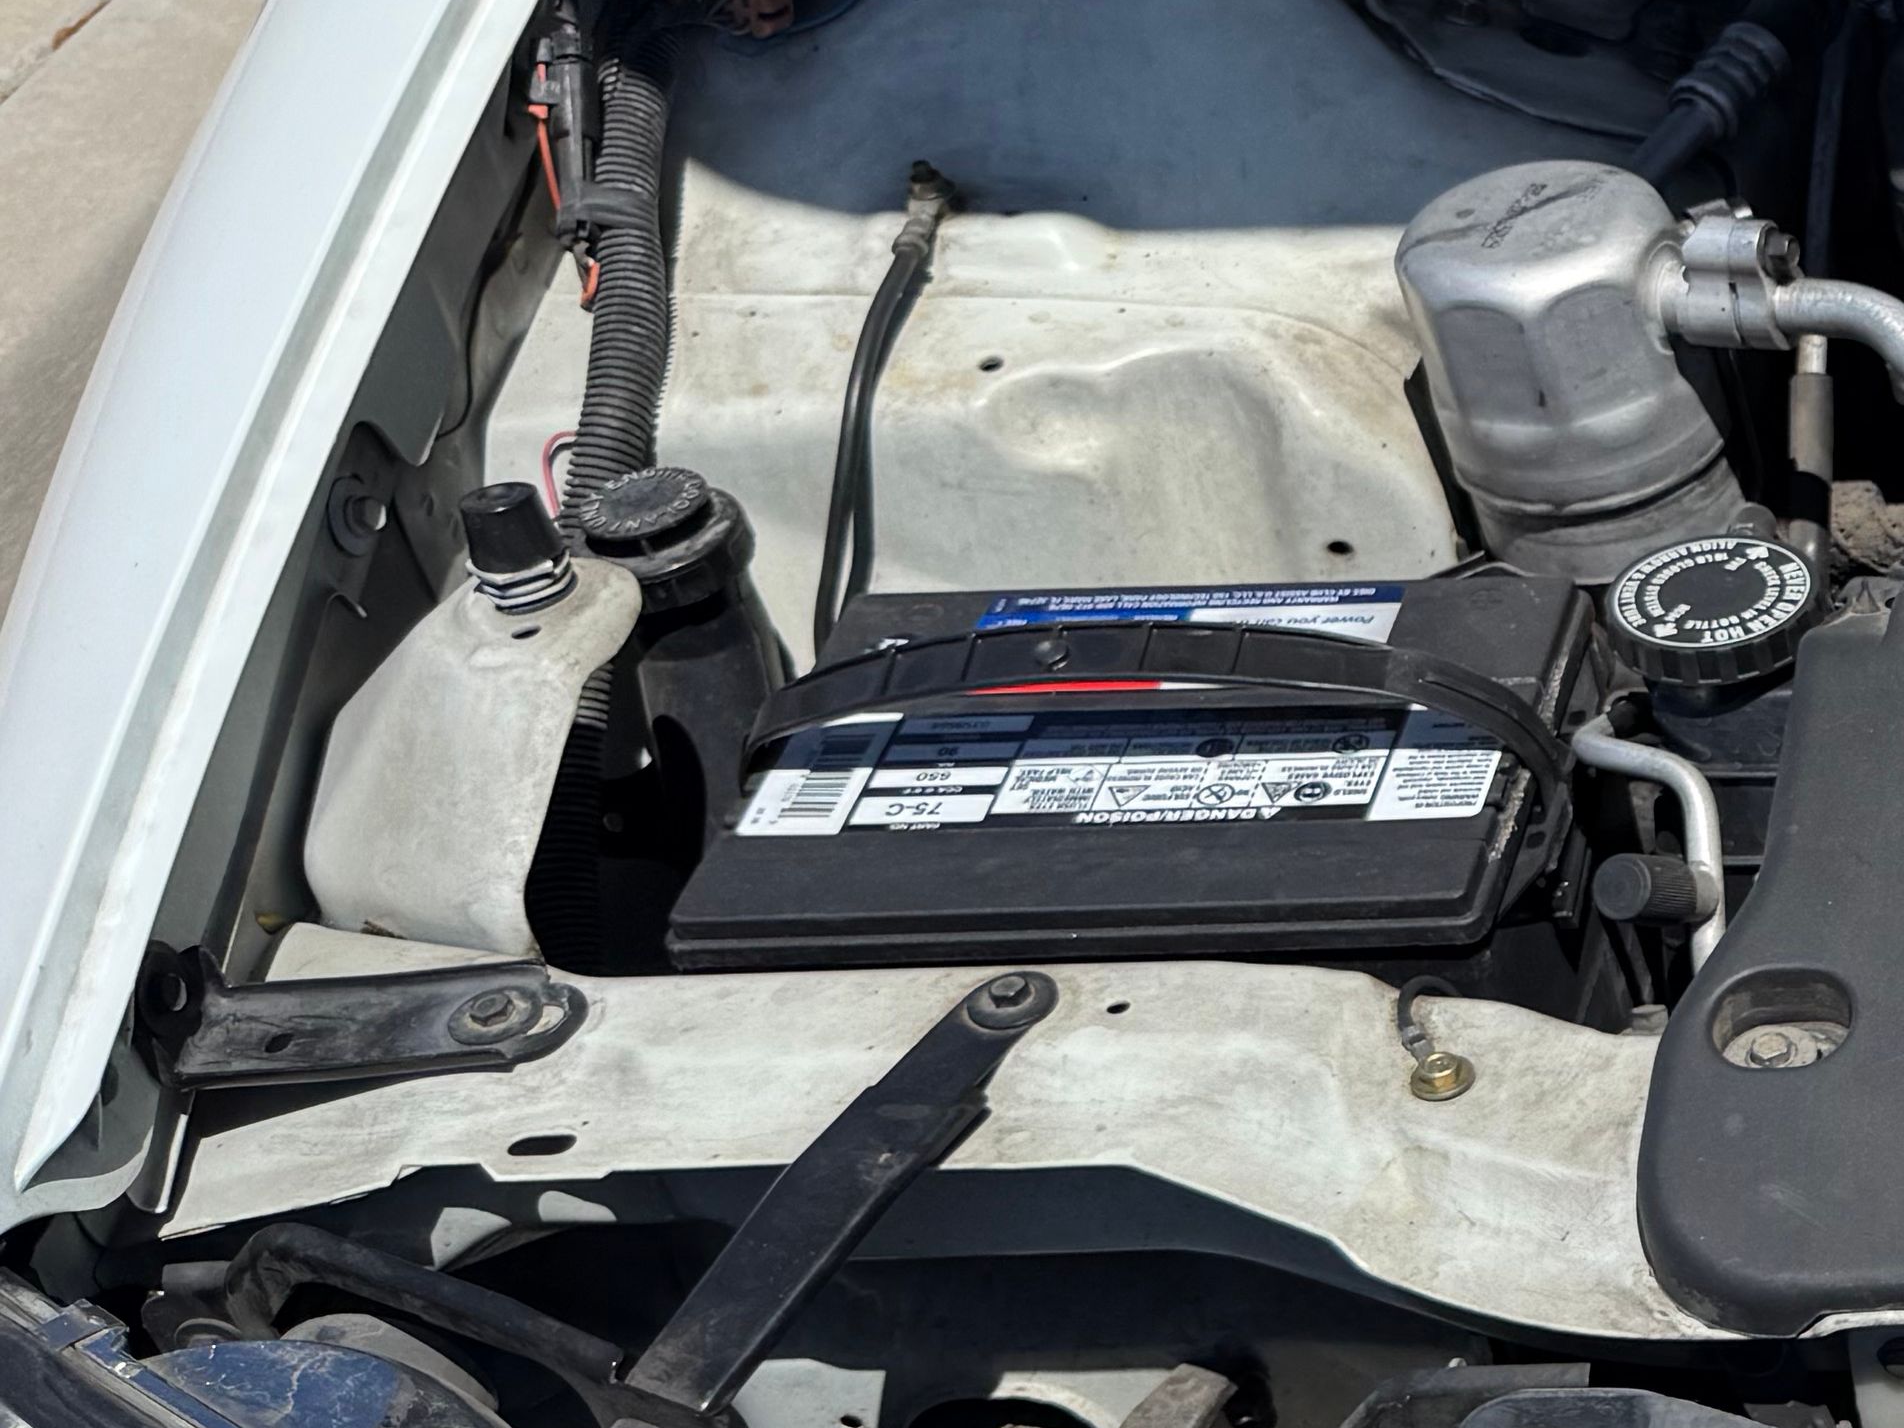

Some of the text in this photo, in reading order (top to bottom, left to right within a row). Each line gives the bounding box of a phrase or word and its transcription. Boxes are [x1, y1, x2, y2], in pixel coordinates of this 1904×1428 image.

[581, 493, 607, 529] ONLY
[1753, 561, 1781, 586] CHECK
[1778, 562, 1806, 600] NEVER
[1287, 616, 1375, 625] Power you
[1683, 615, 1740, 629] BOTTLE
[1747, 602, 1796, 633] OPEN
[1700, 625, 1745, 643] HOT
[885, 801, 944, 817] 75-C
[1074, 808, 1257, 823] DANGER/POISON
